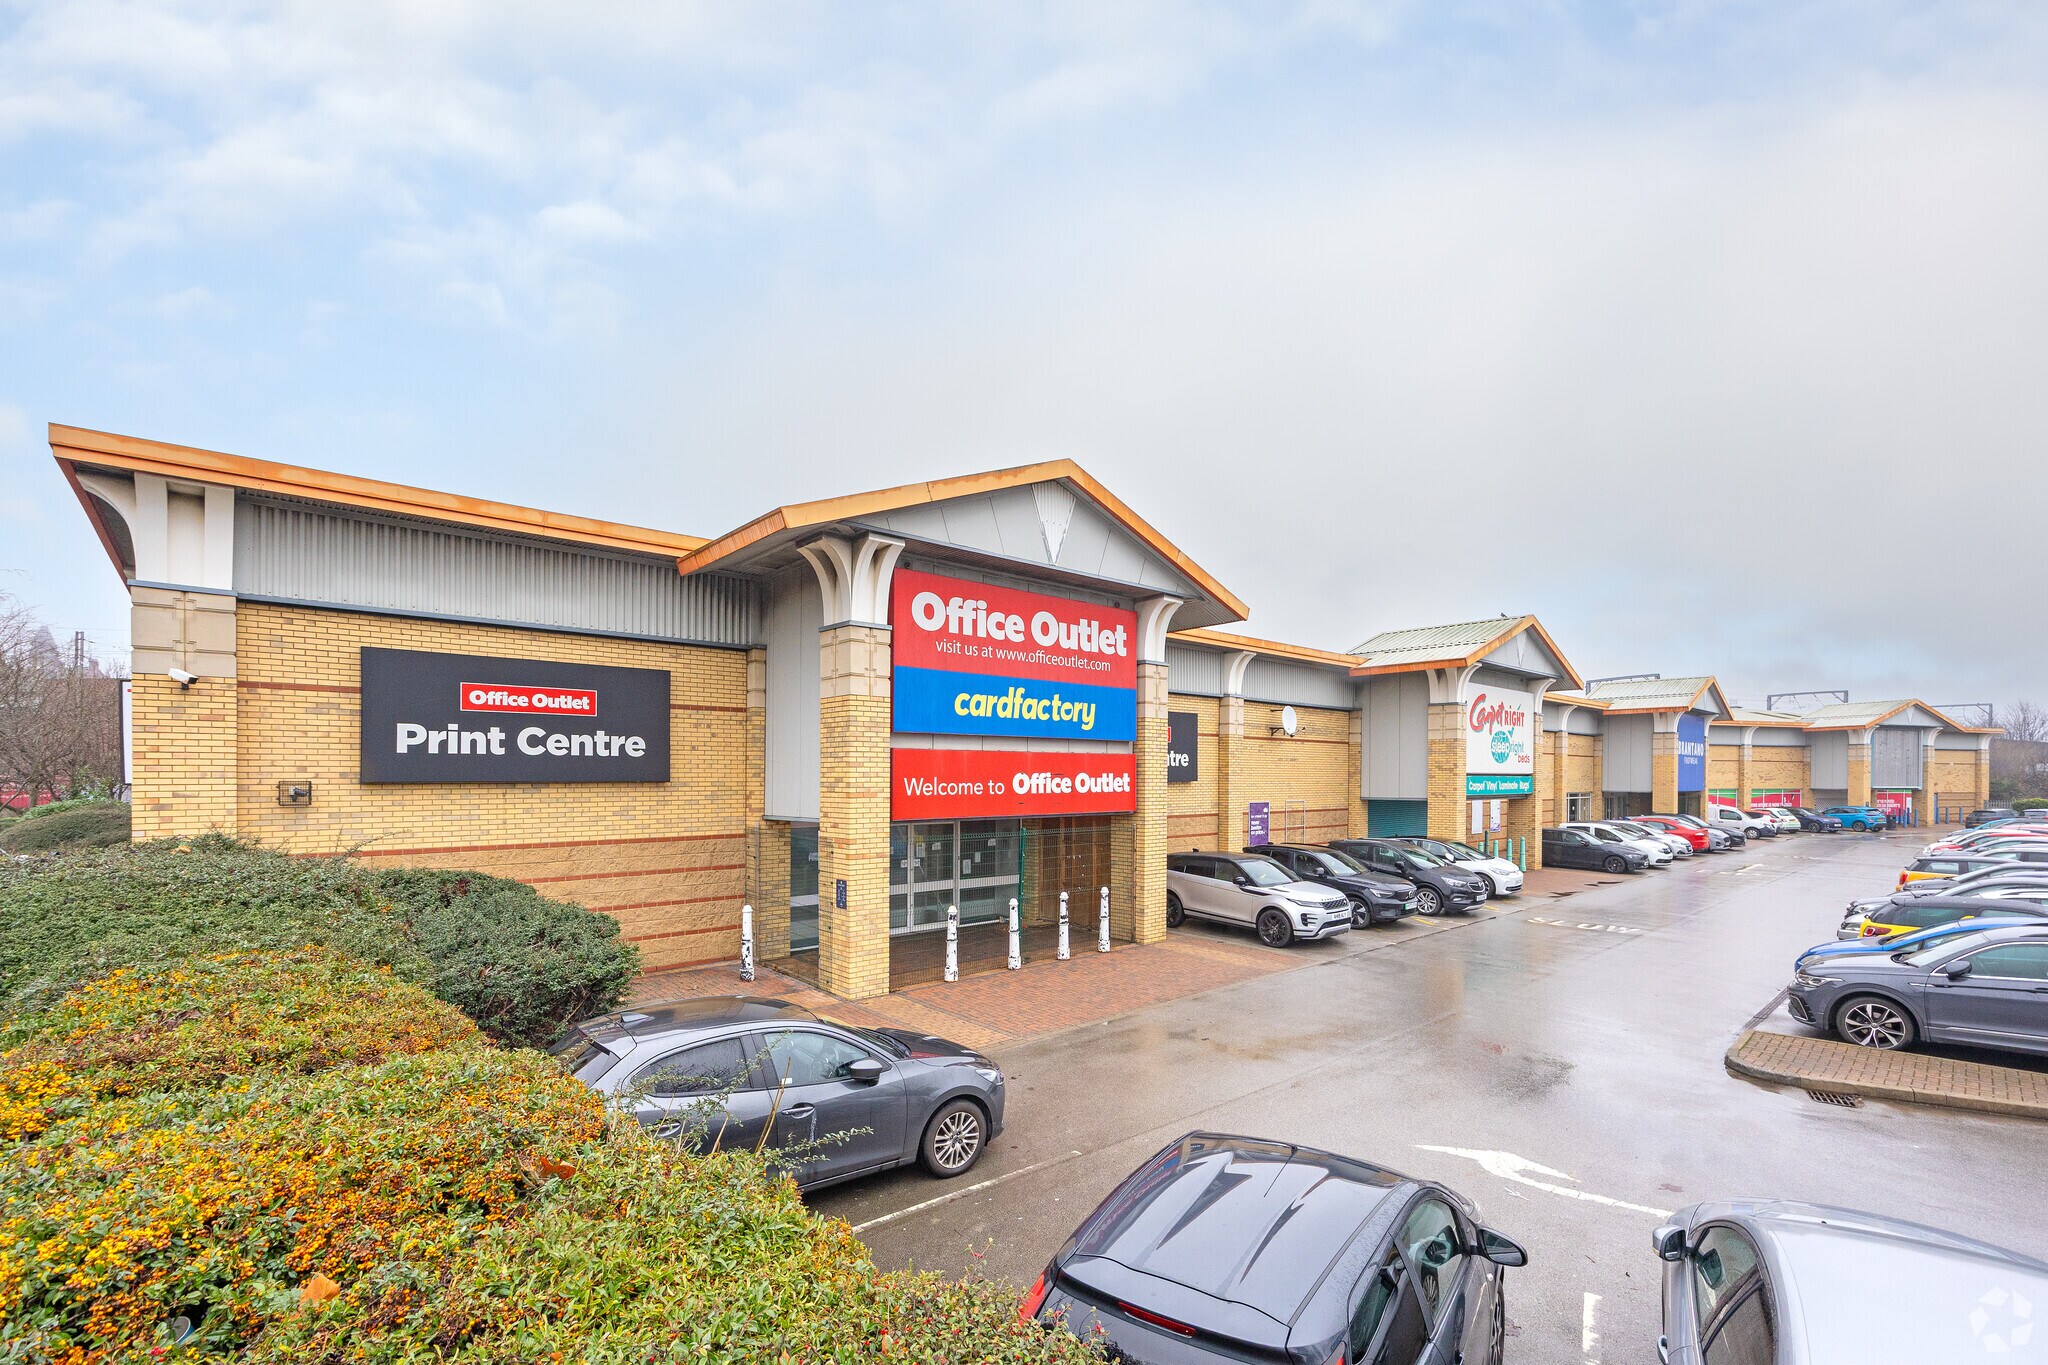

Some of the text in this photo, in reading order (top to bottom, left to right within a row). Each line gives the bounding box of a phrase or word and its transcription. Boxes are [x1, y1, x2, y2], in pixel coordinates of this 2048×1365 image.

[911, 591, 1127, 657] Office Outlet
[935, 638, 1111, 672] visit us at www.officeoutlet.com
[468, 689, 590, 711] Office Outlet
[954, 686, 1096, 731] cardfactory
[396, 723, 646, 758] Print Centre
[1167, 750, 1190, 767] tre
[1517, 754, 1531, 764] beds
[903, 772, 1131, 797] Welcome to Office Outlet
